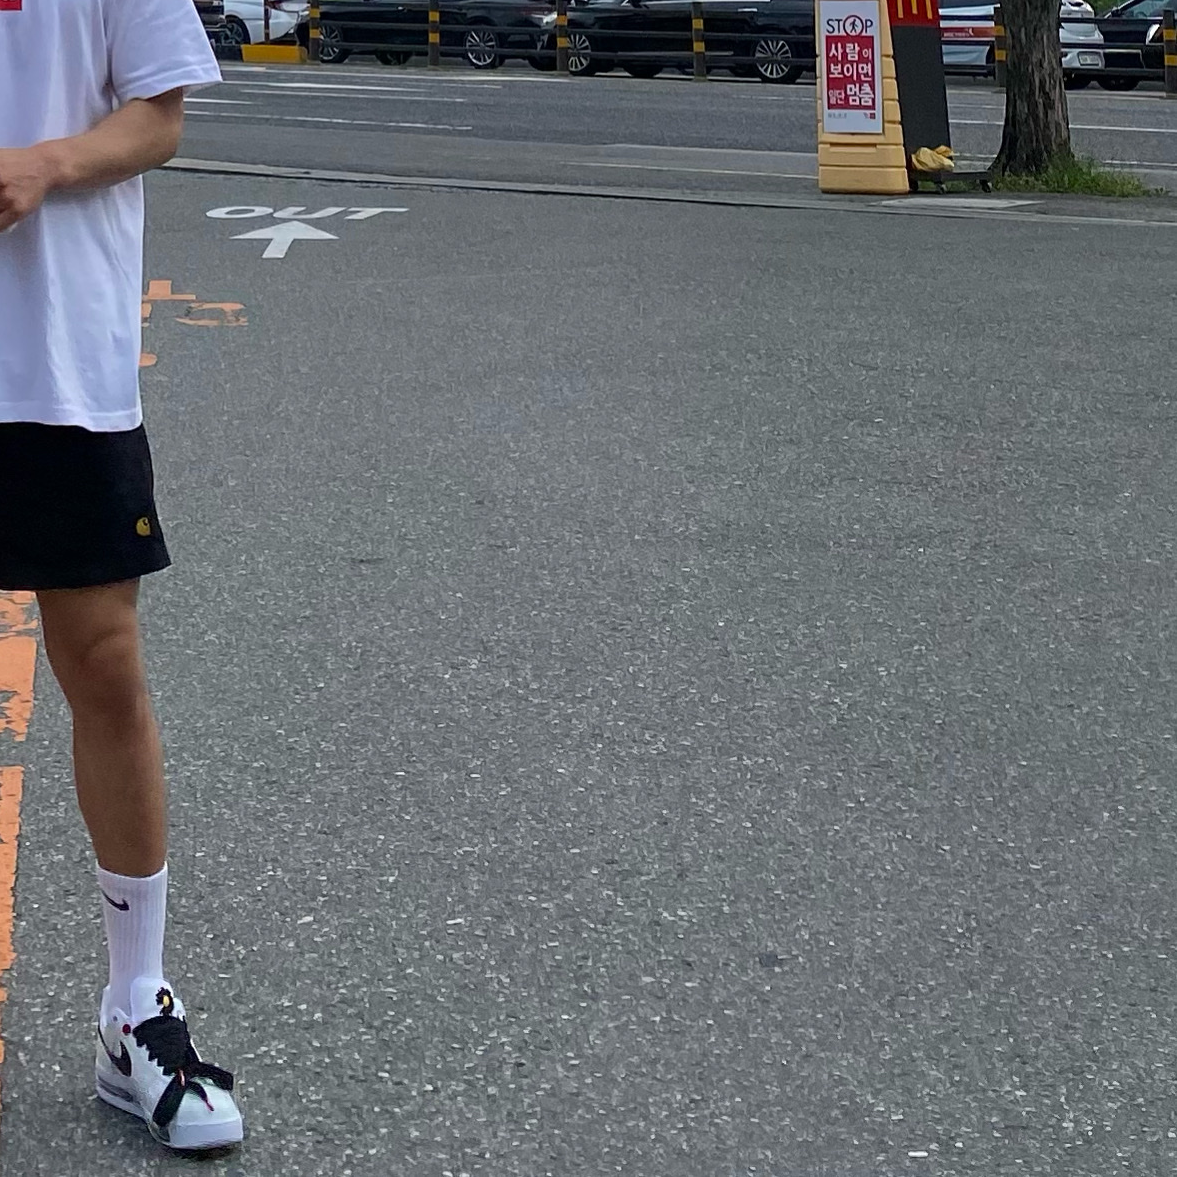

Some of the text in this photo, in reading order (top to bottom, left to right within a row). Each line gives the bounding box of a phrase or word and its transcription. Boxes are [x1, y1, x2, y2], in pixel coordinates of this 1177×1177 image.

[829, 42, 872, 61] 사람이
[829, 63, 872, 81] 보이면
[829, 83, 874, 106] 일단 멈춤
[206, 206, 410, 220] OUT
